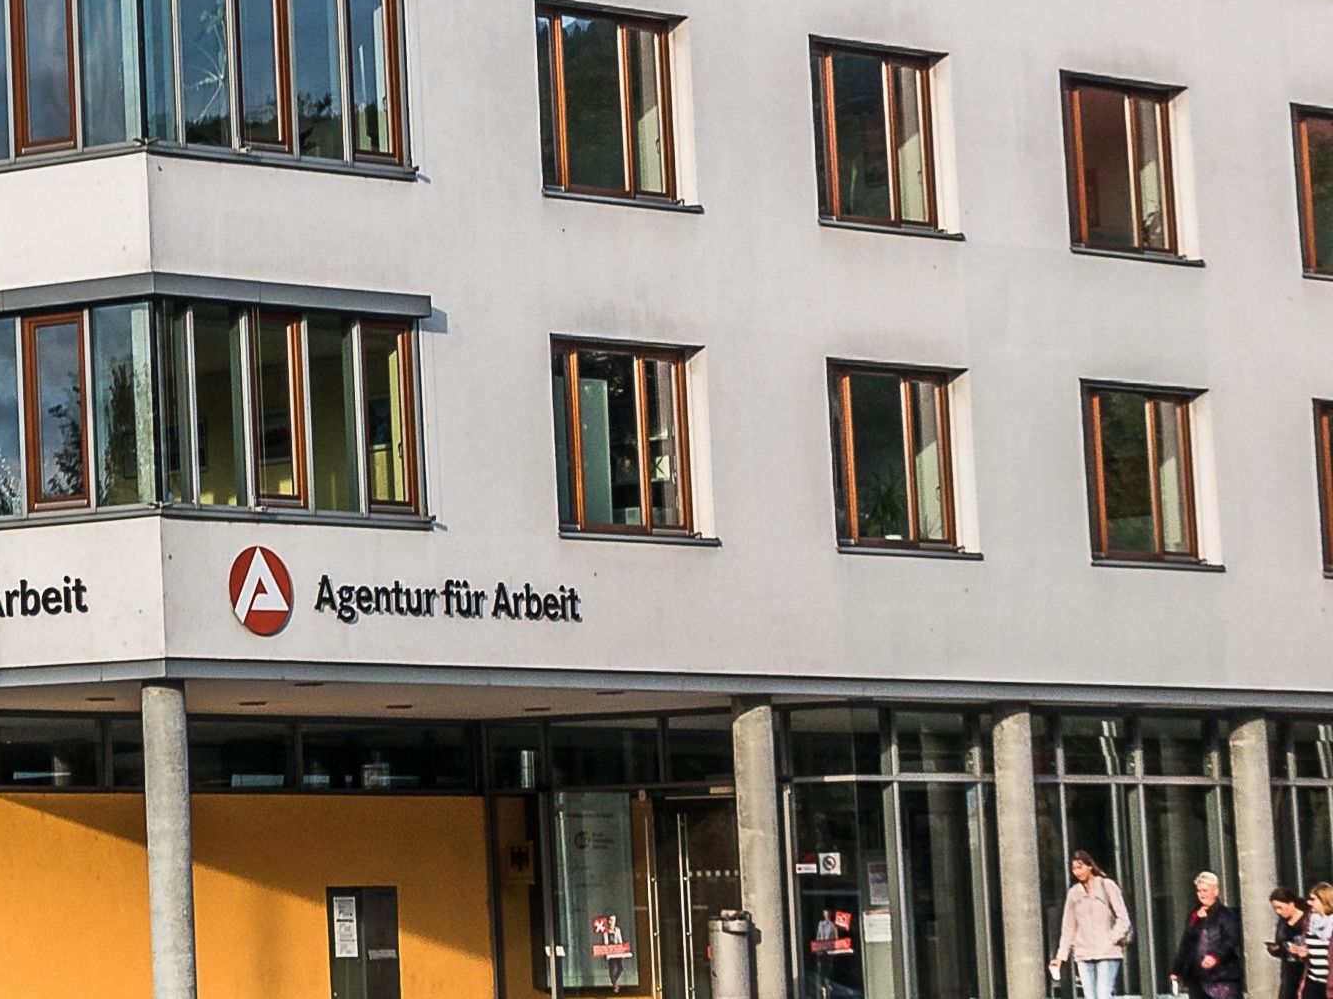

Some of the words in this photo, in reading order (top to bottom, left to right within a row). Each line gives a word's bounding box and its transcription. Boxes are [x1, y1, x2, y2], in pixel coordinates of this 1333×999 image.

[314, 574, 438, 623] Agentur
[443, 578, 485, 618] für
[491, 581, 583, 622] Arbeit
